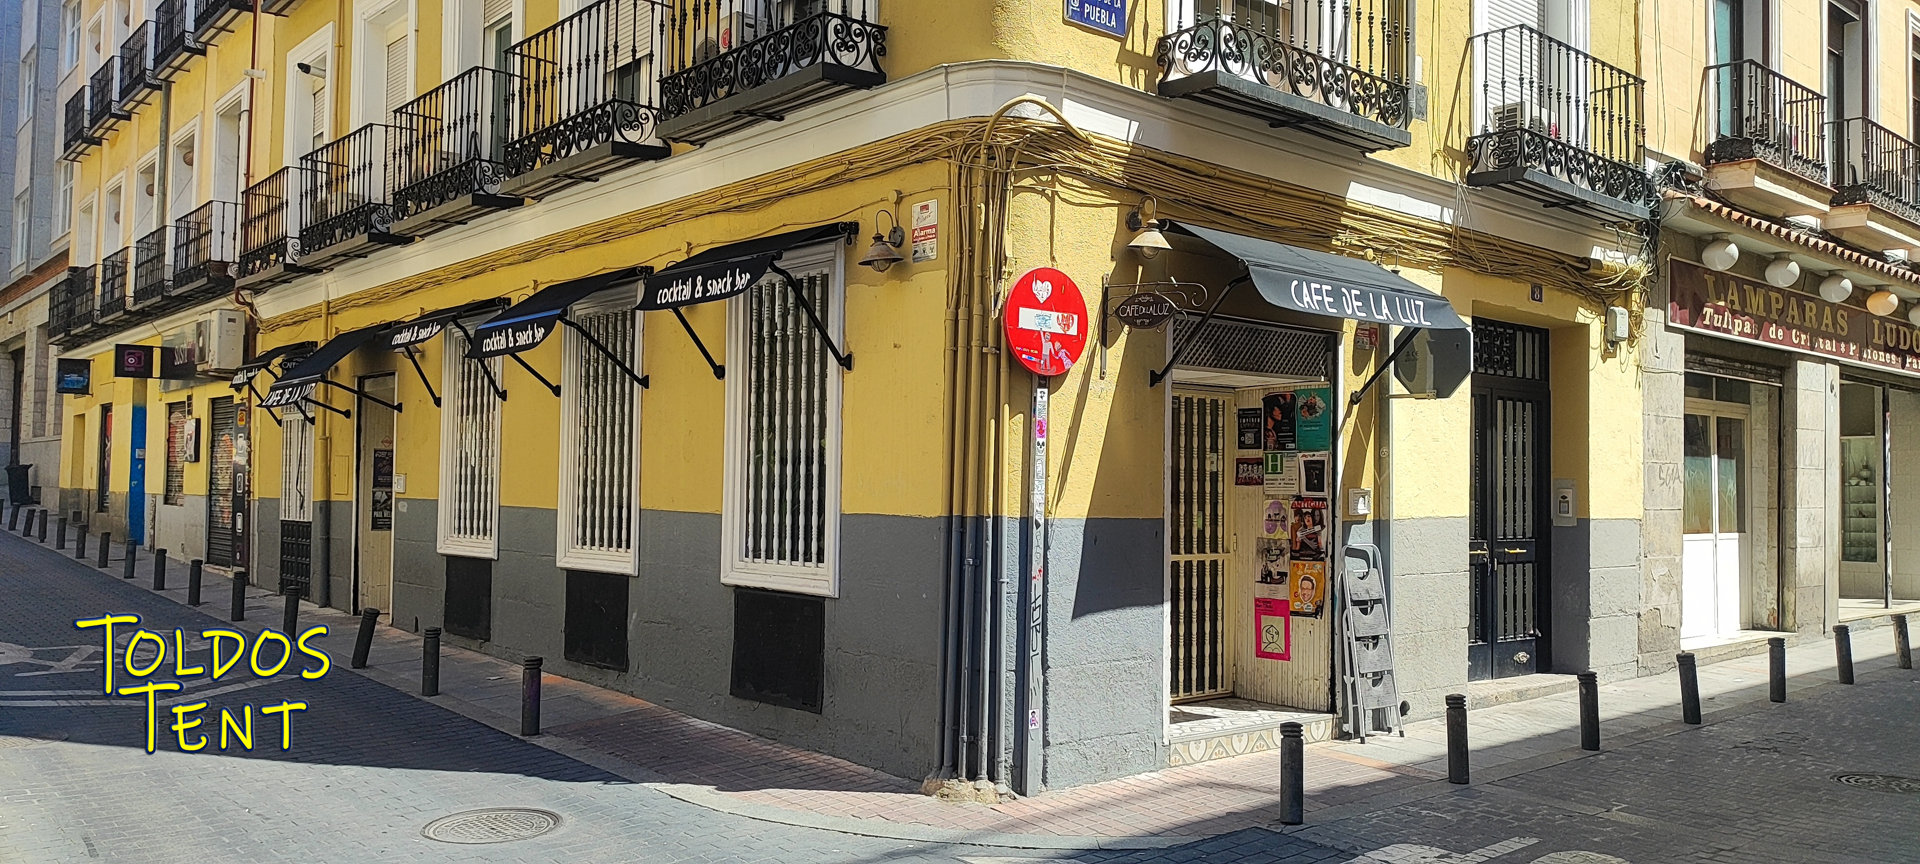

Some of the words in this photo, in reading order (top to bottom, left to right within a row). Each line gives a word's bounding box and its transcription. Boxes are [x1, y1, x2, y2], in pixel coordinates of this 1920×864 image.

[1084, 3, 1116, 28] PUEBLA
[656, 277, 692, 304] cocktail
[695, 275, 703, 298] &
[706, 269, 733, 297] snack
[734, 267, 751, 291] bar
[1534, 287, 1540, 300] 8
[1120, 304, 1139, 316] CAFE
[1153, 302, 1169, 316] LUZ
[1290, 279, 1338, 313] CAFE
[1341, 287, 1367, 317] DE
[1369, 292, 1394, 321] LA
[1395, 296, 1432, 326] LUZ
[1703, 273, 1848, 337] LAMPARAS
[482, 329, 506, 352] cocktail
[508, 327, 514, 347] &
[515, 324, 533, 346] snack
[533, 322, 545, 343] bar
[1768, 322, 1784, 341] de
[1267, 453, 1283, 473] H
